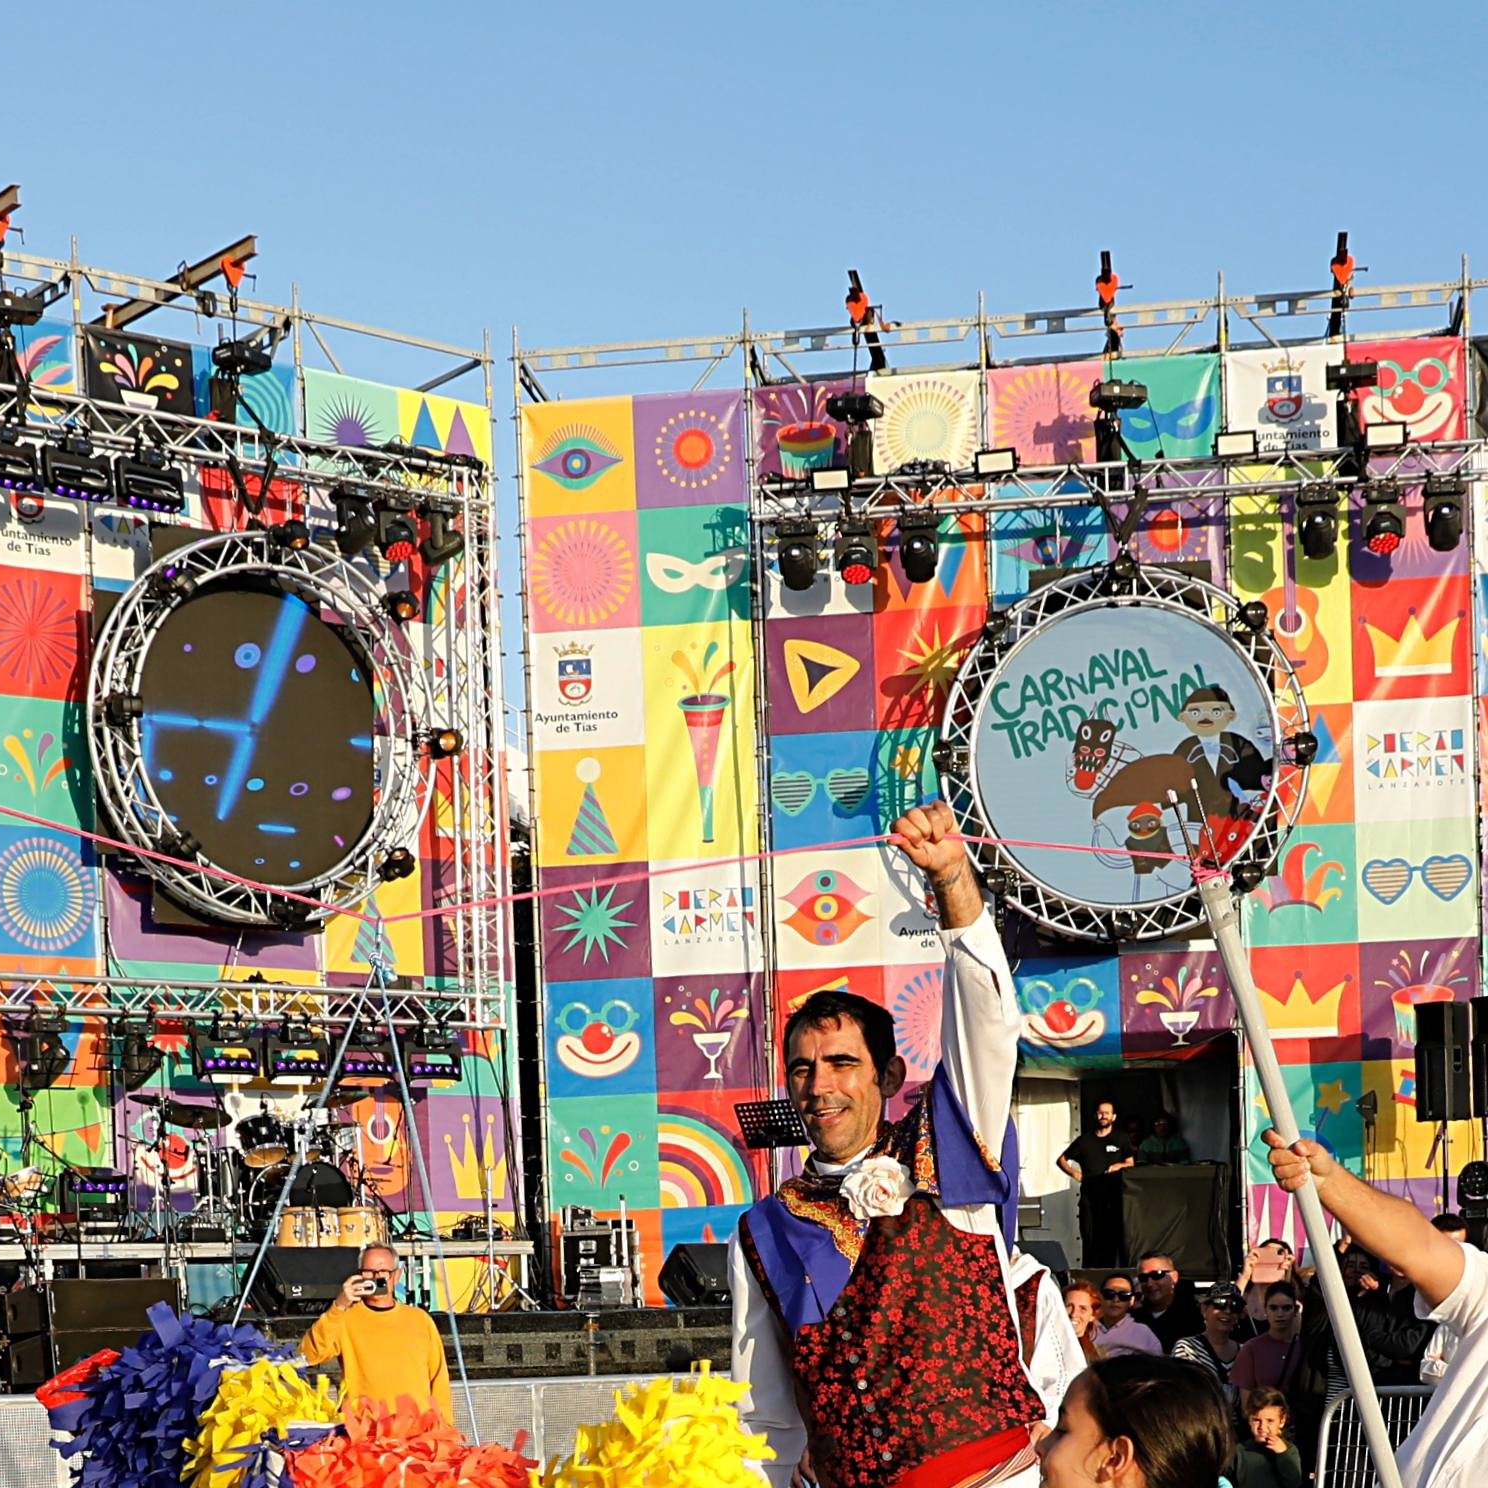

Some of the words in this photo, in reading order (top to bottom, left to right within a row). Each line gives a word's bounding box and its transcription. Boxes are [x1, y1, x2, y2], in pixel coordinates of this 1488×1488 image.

[1258, 428, 1330, 441] untamiento
[7, 542, 22, 552] de
[991, 648, 1167, 720] CARNAVAL
[534, 710, 619, 725] Ayuntamiento
[991, 664, 1220, 759] TRADCIONAL
[555, 722, 570, 733] de
[920, 938, 935, 948] de
